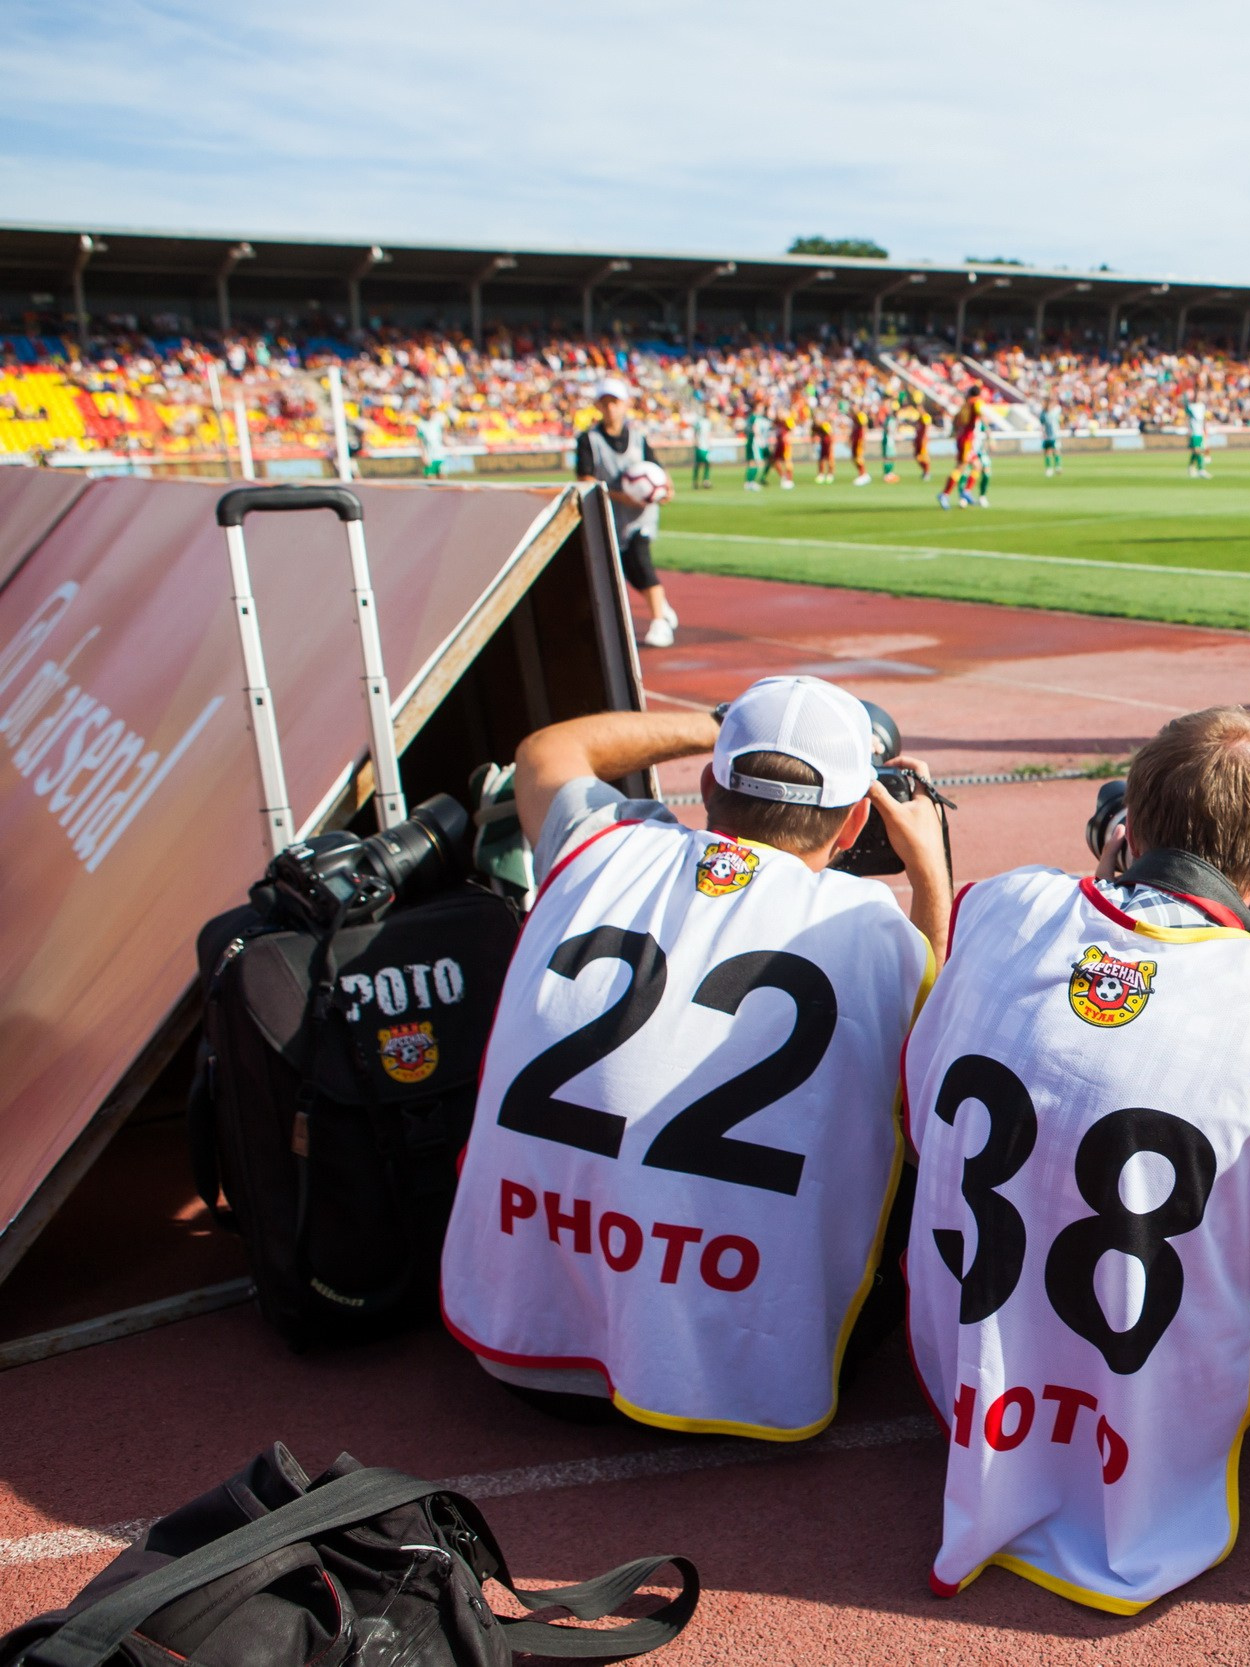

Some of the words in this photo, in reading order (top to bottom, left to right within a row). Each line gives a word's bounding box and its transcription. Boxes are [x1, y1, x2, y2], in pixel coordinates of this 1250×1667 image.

[1081, 962, 1147, 991] АРСЕНАЛ
[1084, 1005, 1116, 1023] ТУЛА
[496, 925, 838, 1197] 22
[500, 1178, 761, 1293] PHOTO
[931, 1053, 1217, 1376] 38
